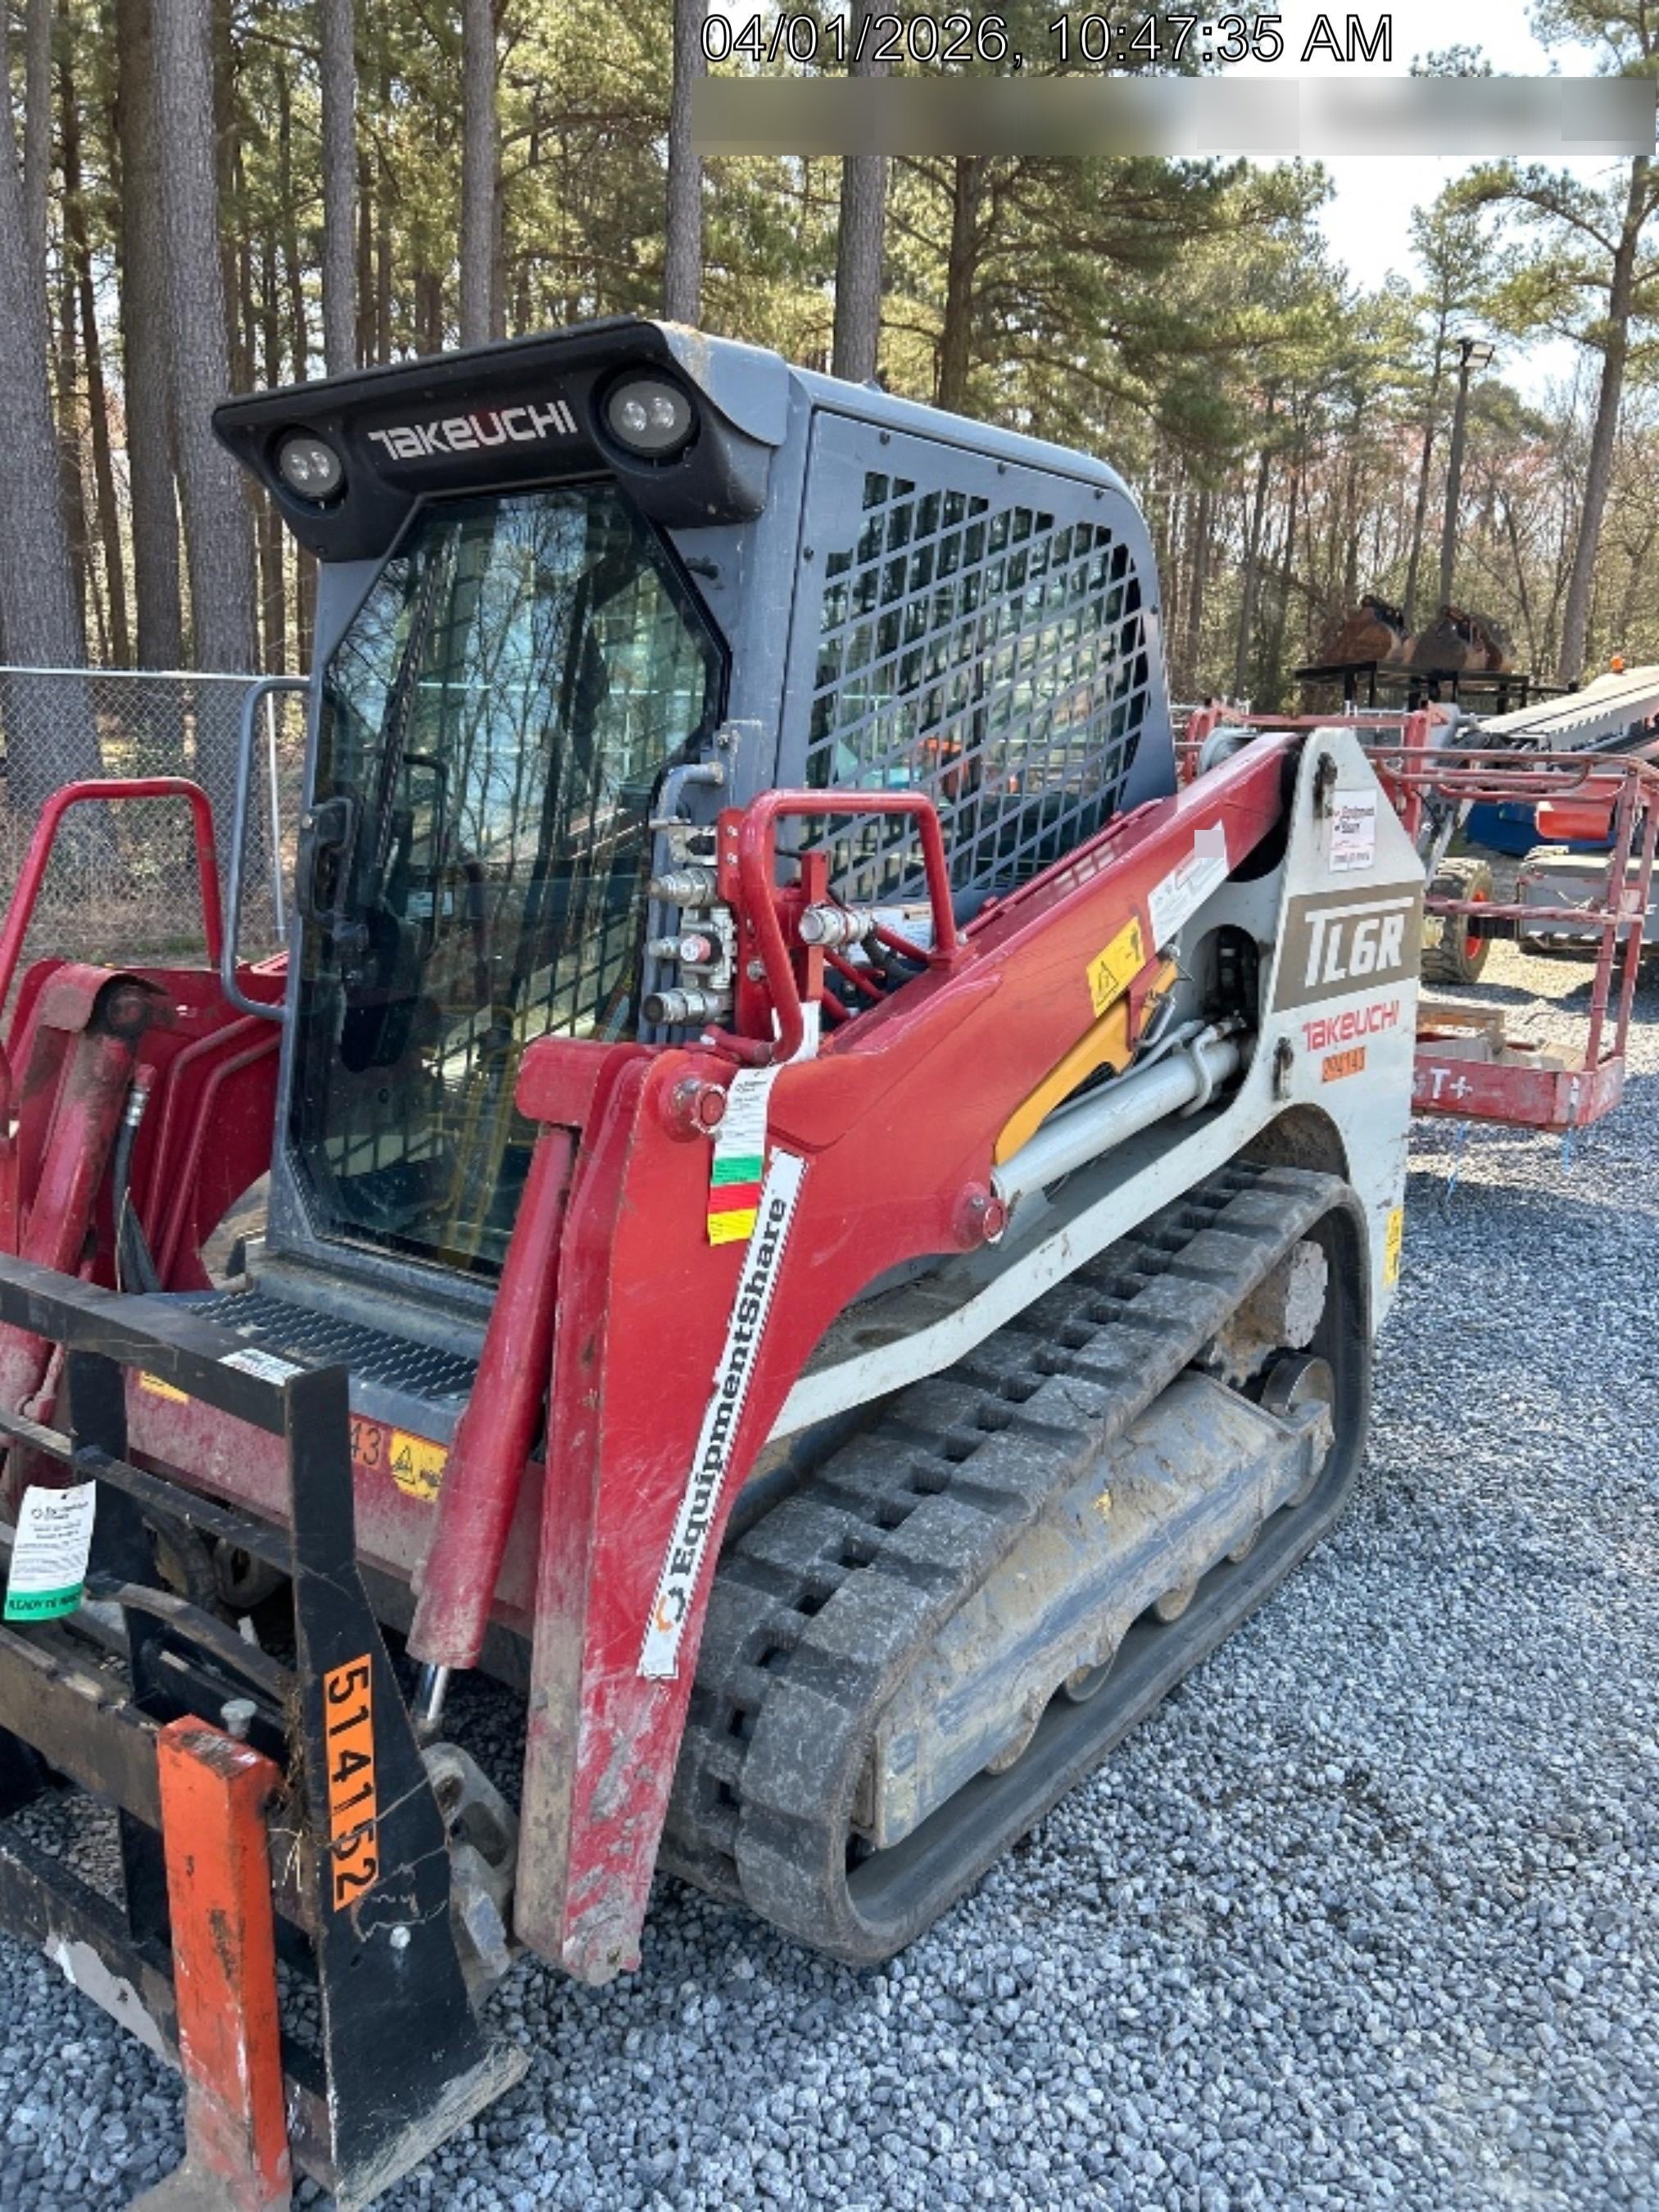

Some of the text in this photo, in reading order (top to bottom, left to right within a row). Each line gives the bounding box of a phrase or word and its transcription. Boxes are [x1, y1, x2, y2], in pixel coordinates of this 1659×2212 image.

[368, 400, 578, 460] TAKEUCHI
[1304, 896, 1415, 989] TL6R
[1301, 999, 1399, 1052] TAKEUCHI
[669, 1197, 787, 1578] EquipmentShare
[329, 1665, 377, 1902] 514152
